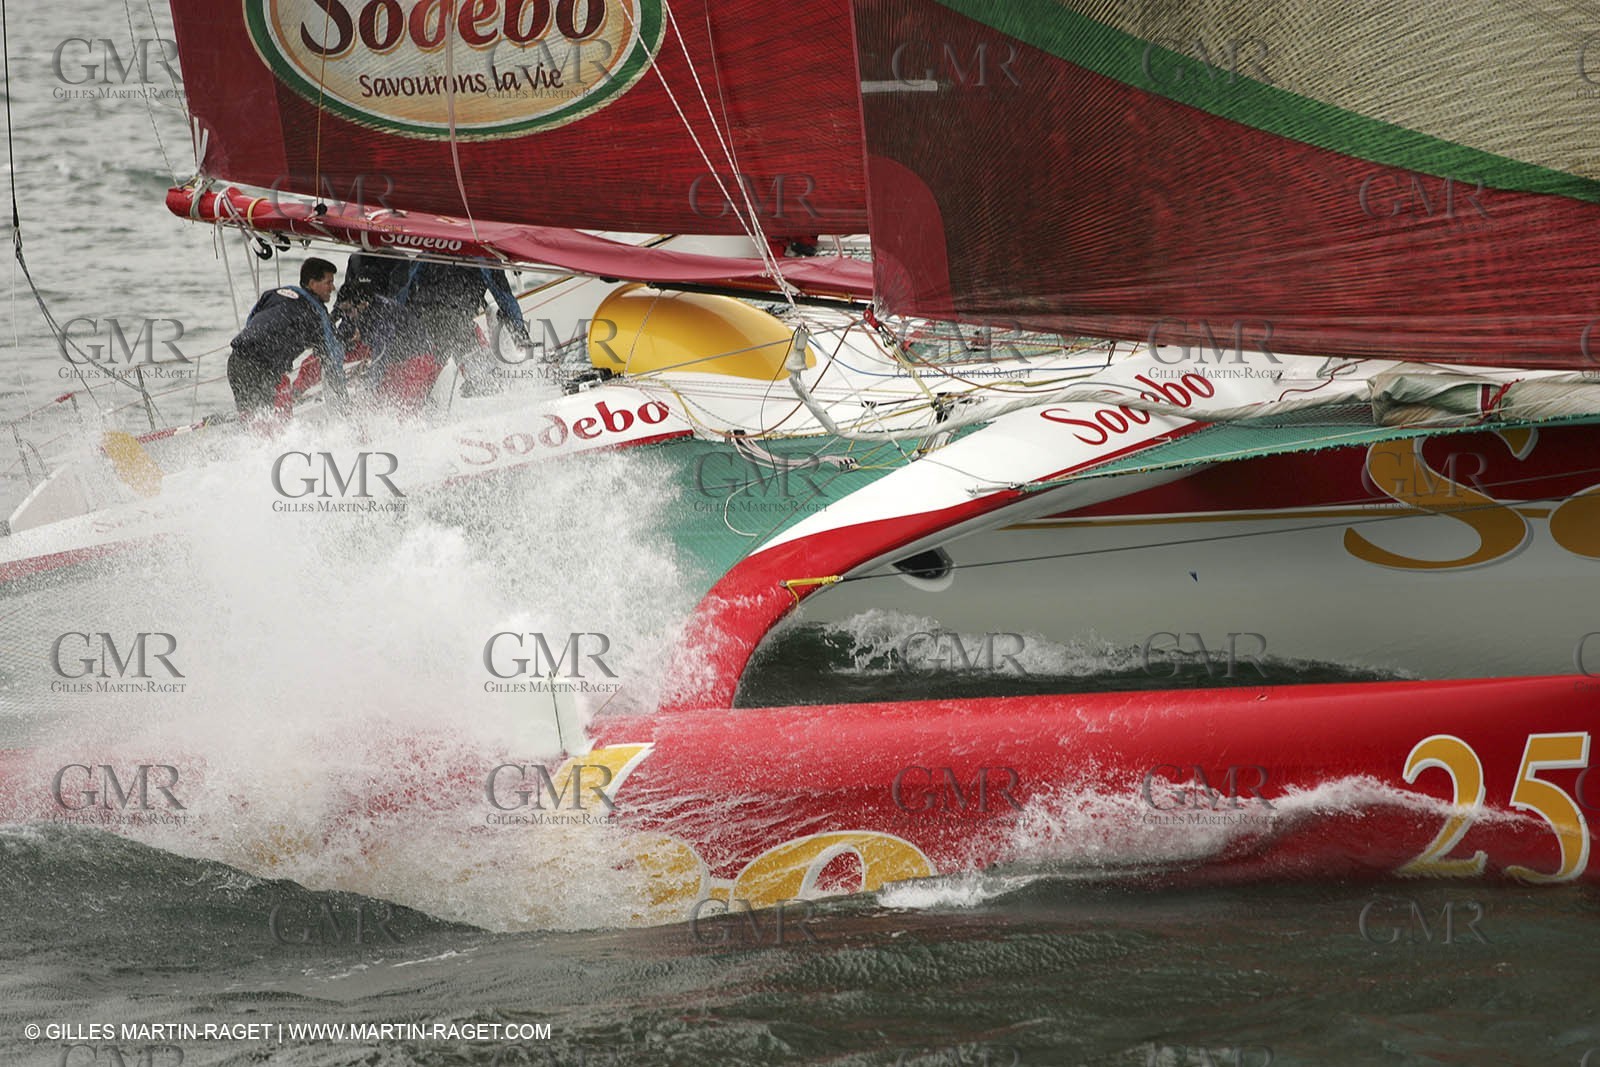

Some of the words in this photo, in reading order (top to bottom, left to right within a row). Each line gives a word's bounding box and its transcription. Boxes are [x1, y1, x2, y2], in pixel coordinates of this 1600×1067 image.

[359, 72, 487, 98] Savourons
[492, 65, 520, 92] la
[524, 62, 564, 91] Vie
[1398, 731, 1590, 884] 25
